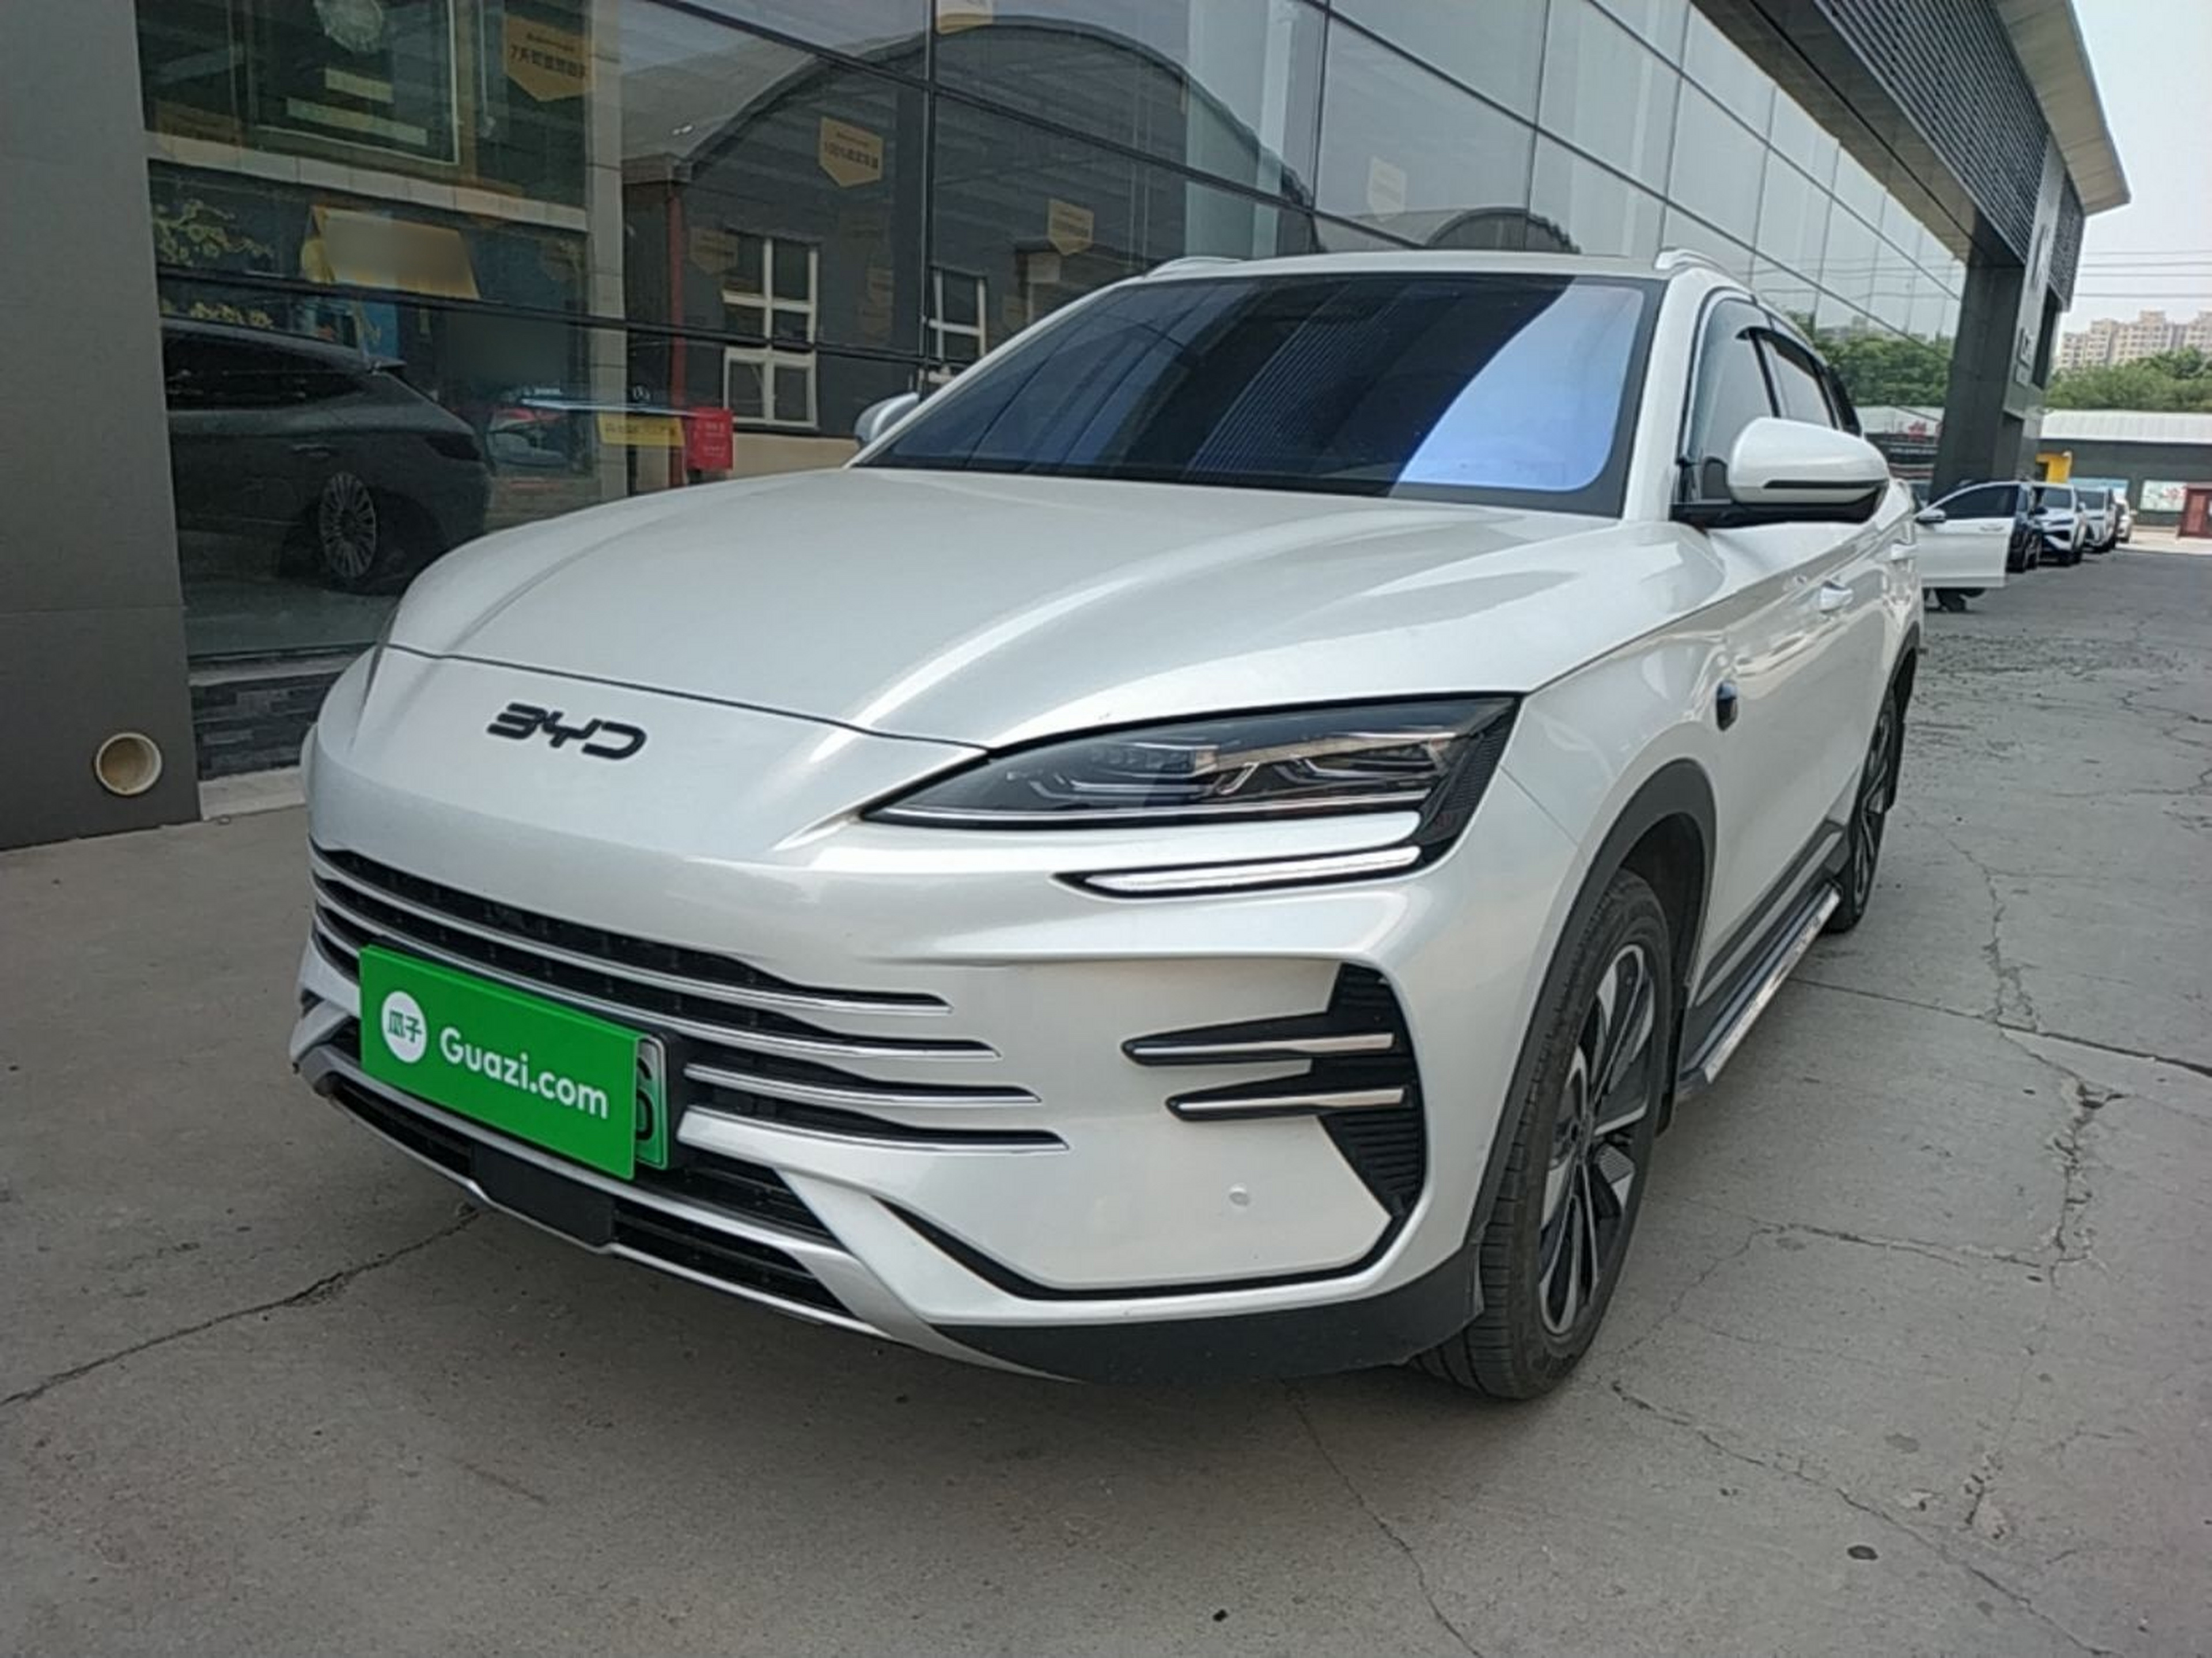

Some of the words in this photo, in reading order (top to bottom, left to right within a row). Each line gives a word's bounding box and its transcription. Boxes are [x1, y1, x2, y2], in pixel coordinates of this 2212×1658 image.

[486, 702, 647, 760] BYD
[388, 1010, 422, 1043] 瓜子
[440, 1026, 608, 1120] Guazi.com
